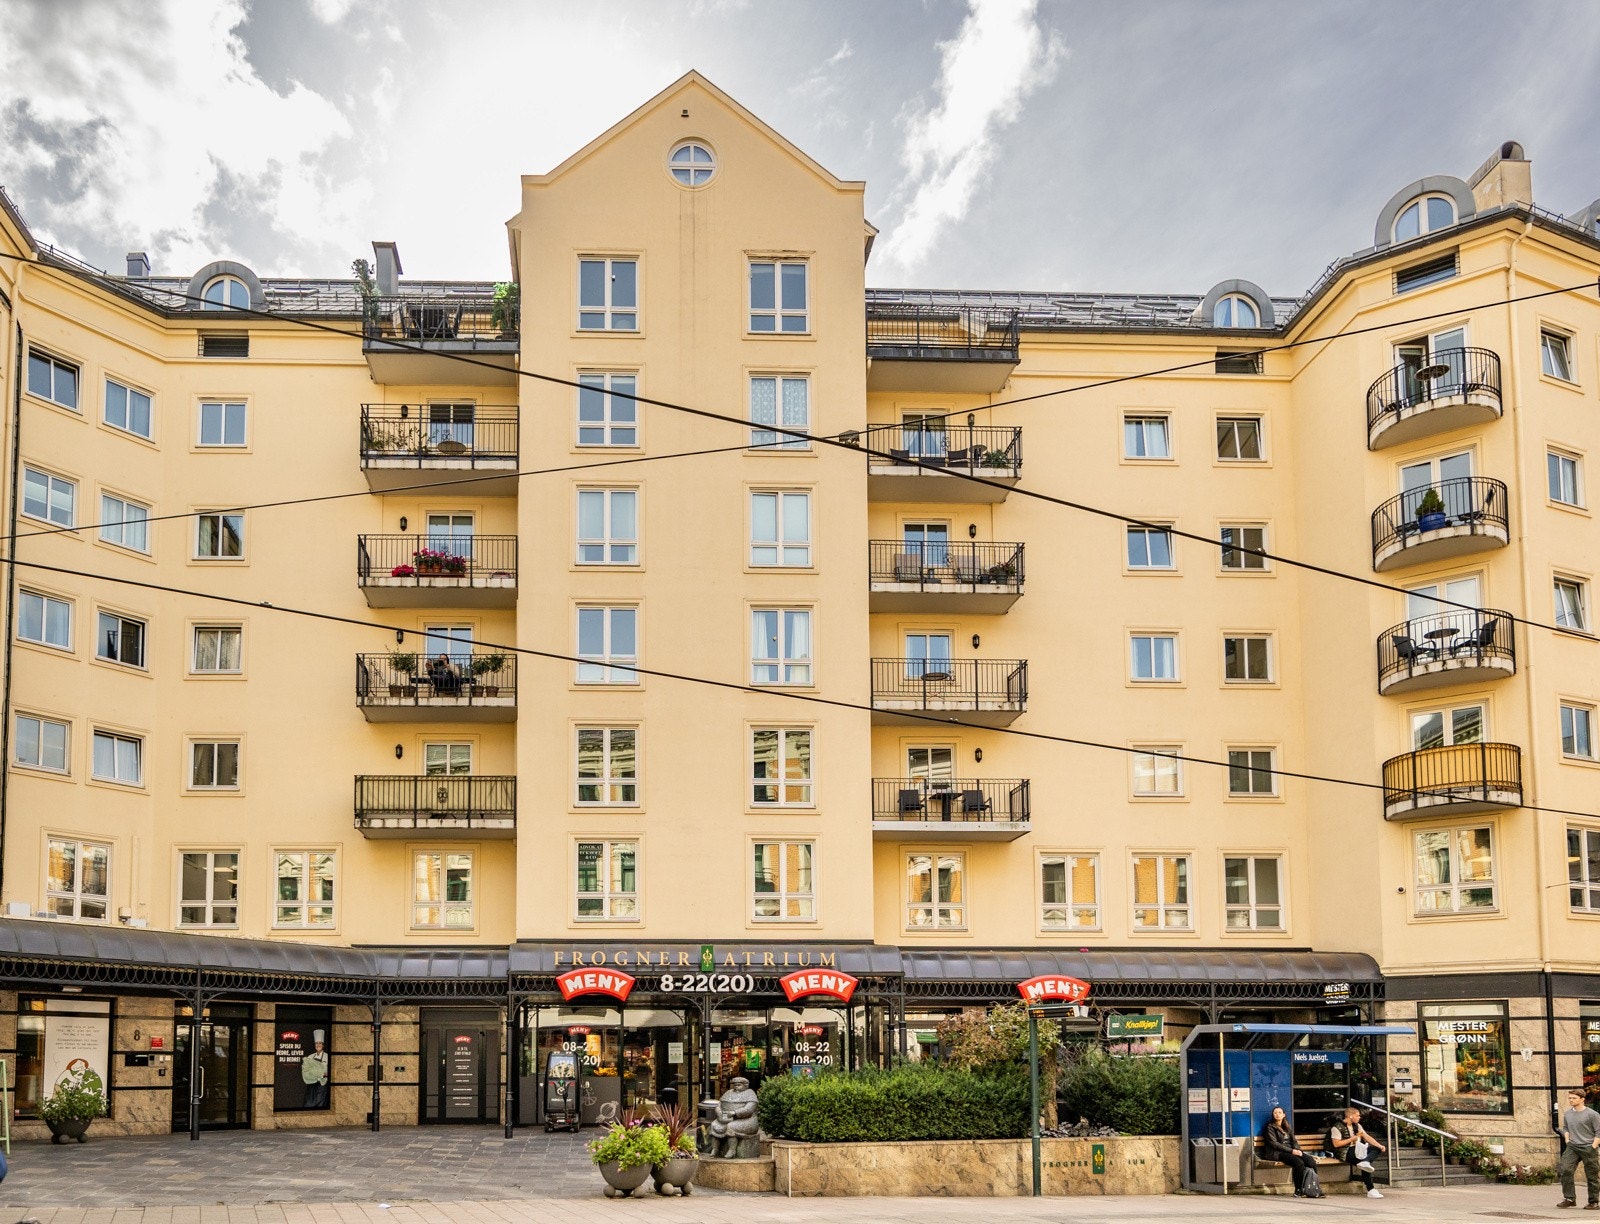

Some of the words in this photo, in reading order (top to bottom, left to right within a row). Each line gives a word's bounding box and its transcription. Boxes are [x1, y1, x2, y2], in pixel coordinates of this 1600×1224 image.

[554, 951, 690, 966] FROGNER
[724, 951, 836, 967] ATRIUM
[564, 973, 627, 993] MENY
[660, 974, 754, 993] 8-22(20)
[789, 974, 851, 994] MENY
[1026, 980, 1085, 999] MENY
[1439, 1021, 1488, 1031] MESTER
[134, 1029, 141, 1042] 8
[1439, 1034, 1487, 1043] GRØNN
[1294, 1053, 1307, 1061] Niels
